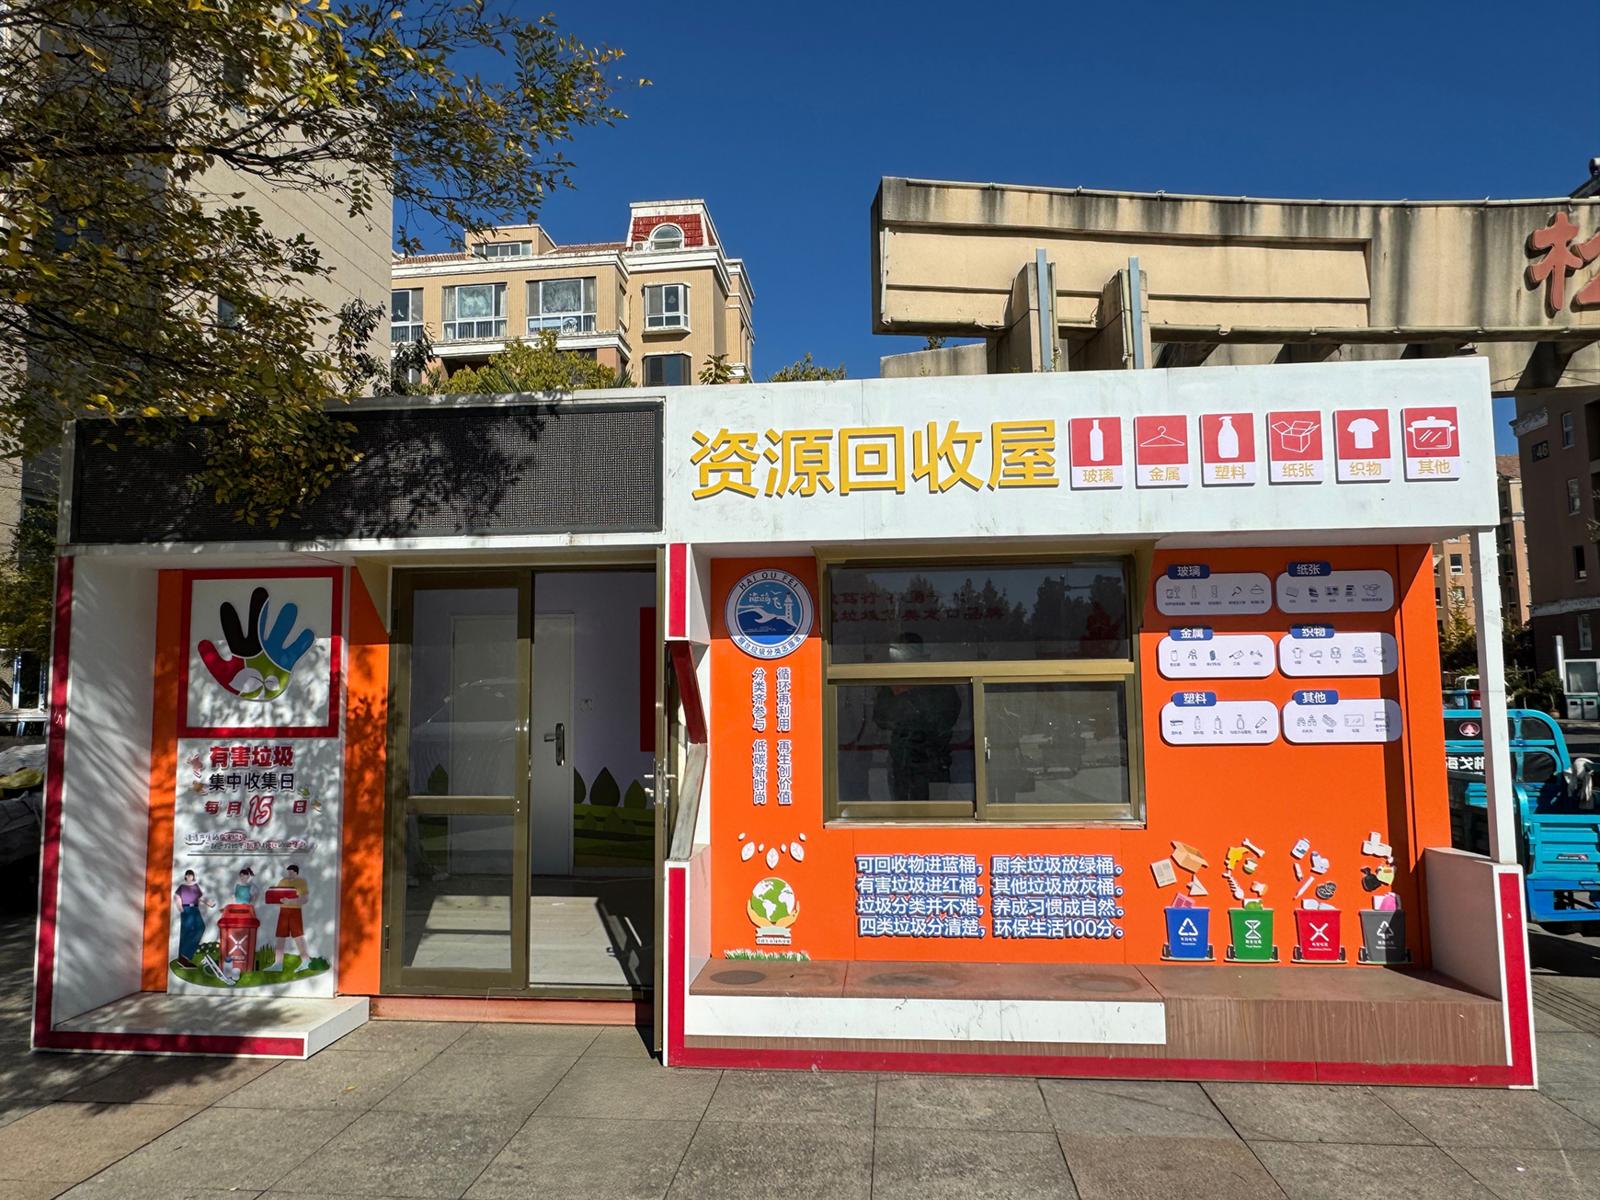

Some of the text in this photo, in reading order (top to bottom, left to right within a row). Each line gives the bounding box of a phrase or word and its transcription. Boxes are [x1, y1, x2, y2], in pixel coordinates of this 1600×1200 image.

[691, 419, 1060, 499] 资源回收屋
[1417, 459, 1452, 475] 其他
[1082, 468, 1115, 484] 玻璃
[1148, 466, 1181, 482] 金属
[1214, 464, 1247, 480] 塑料
[1281, 462, 1315, 478] 纸张
[1349, 461, 1382, 477] 织物
[1177, 565, 1201, 577] 玻璃
[1296, 563, 1321, 575] 纸张
[739, 575, 756, 590] HAI
[782, 575, 798, 588] FEI
[1180, 628, 1204, 639] 金属
[1301, 626, 1326, 638] 织物
[1183, 692, 1207, 704] 塑料
[1302, 692, 1327, 704] 其他
[753, 668, 766, 804] 分类齐参与 低碳新时尚
[778, 668, 791, 804] 循环再利用 再生创价值
[210, 746, 294, 768] 有害垃圾
[209, 773, 295, 791] 集中收集日
